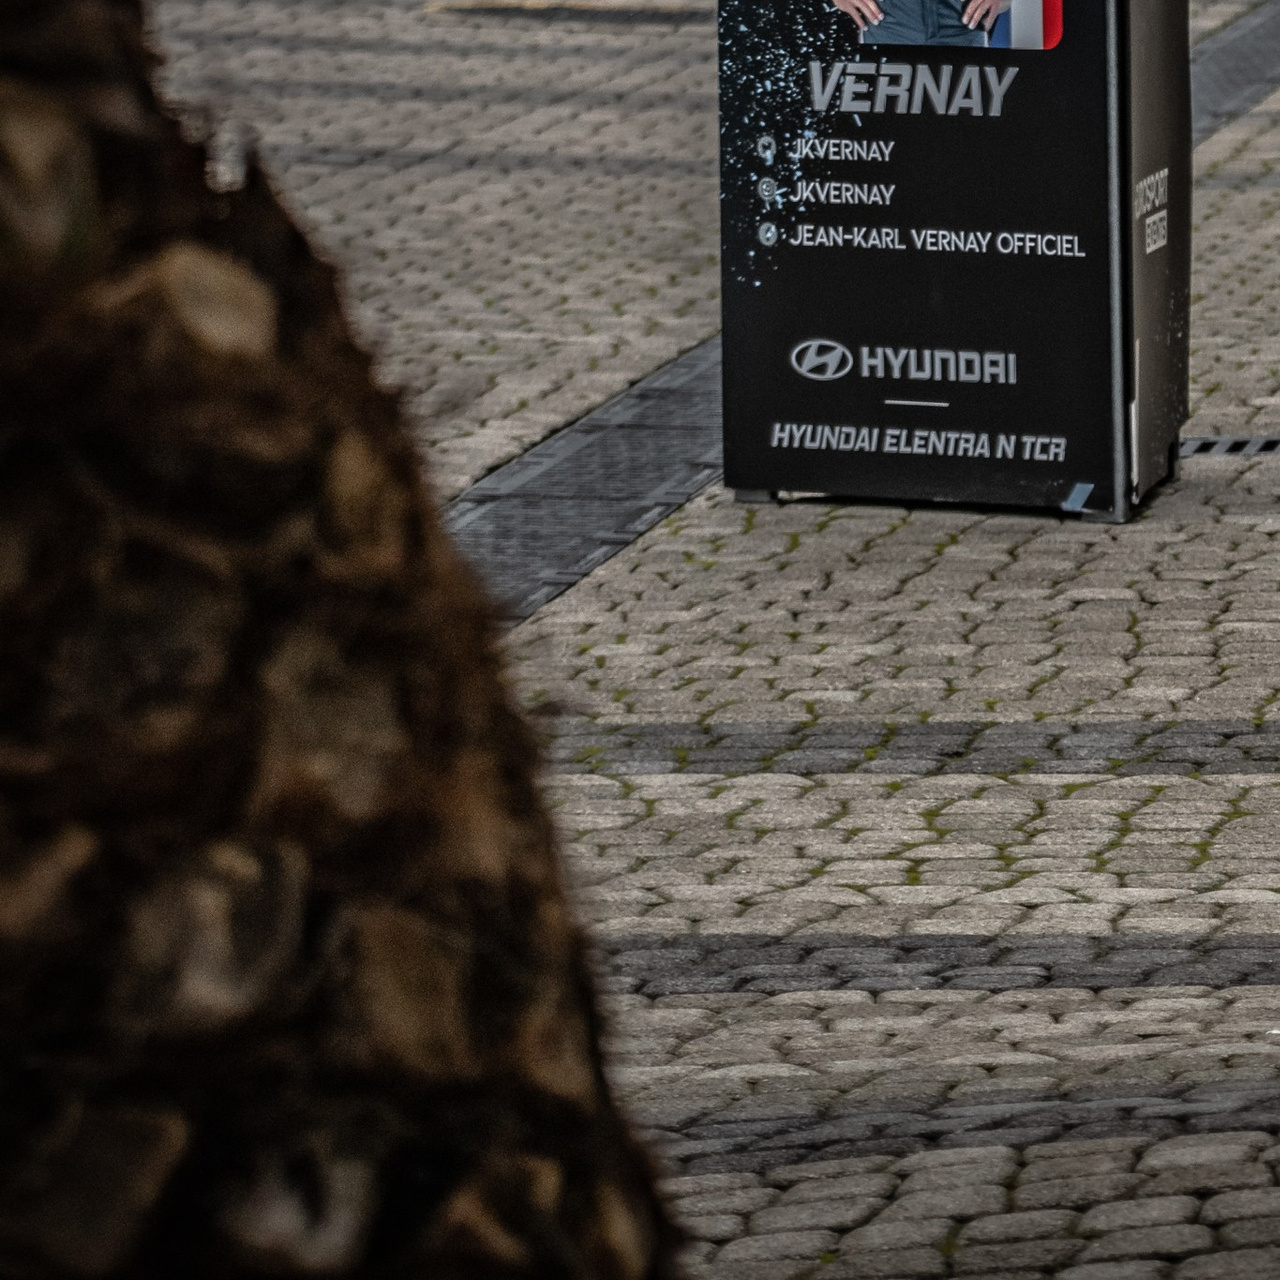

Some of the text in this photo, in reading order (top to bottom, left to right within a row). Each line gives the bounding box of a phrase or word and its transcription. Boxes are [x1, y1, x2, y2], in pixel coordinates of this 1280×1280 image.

[809, 60, 1020, 117] VERNAY
[790, 138, 895, 162] JKVERNAY
[790, 180, 896, 206] JKVERNAY
[790, 224, 1086, 258] JEAN-KARL VERNAY OFFICIEL
[860, 346, 1017, 385] HYUNDAI
[771, 422, 1067, 463] HYUNDAI ELENTRA N TCR
